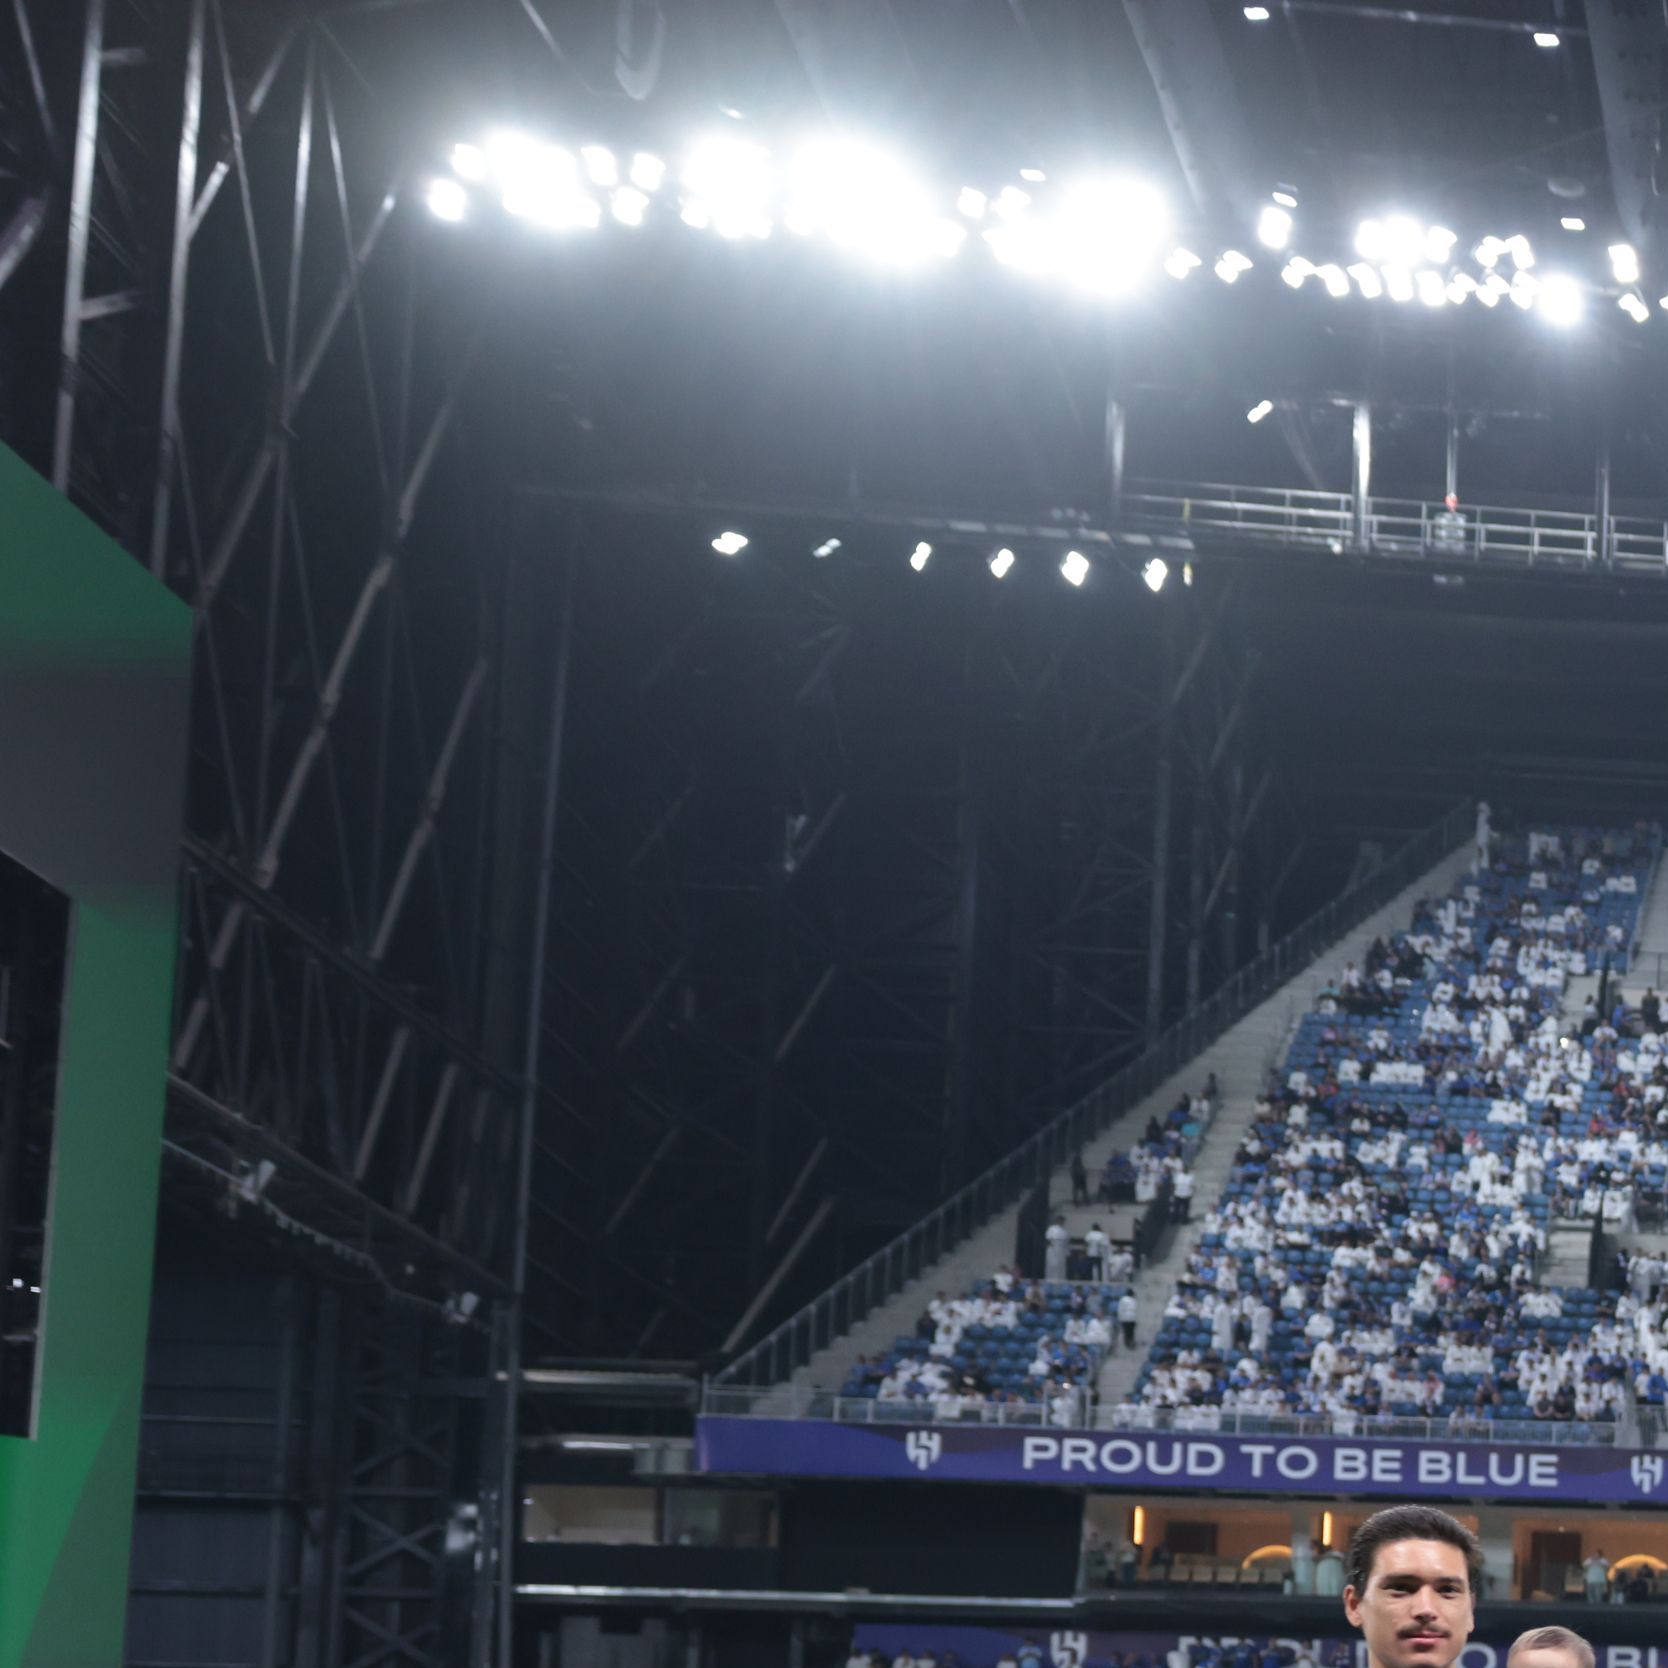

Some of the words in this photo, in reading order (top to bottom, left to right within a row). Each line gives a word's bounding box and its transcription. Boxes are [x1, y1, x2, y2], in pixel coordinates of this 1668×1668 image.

[1022, 1436, 1224, 1476] PROUD
[1240, 1444, 1318, 1479] TO
[1333, 1448, 1403, 1482] BE
[1417, 1451, 1560, 1486] BLUE
